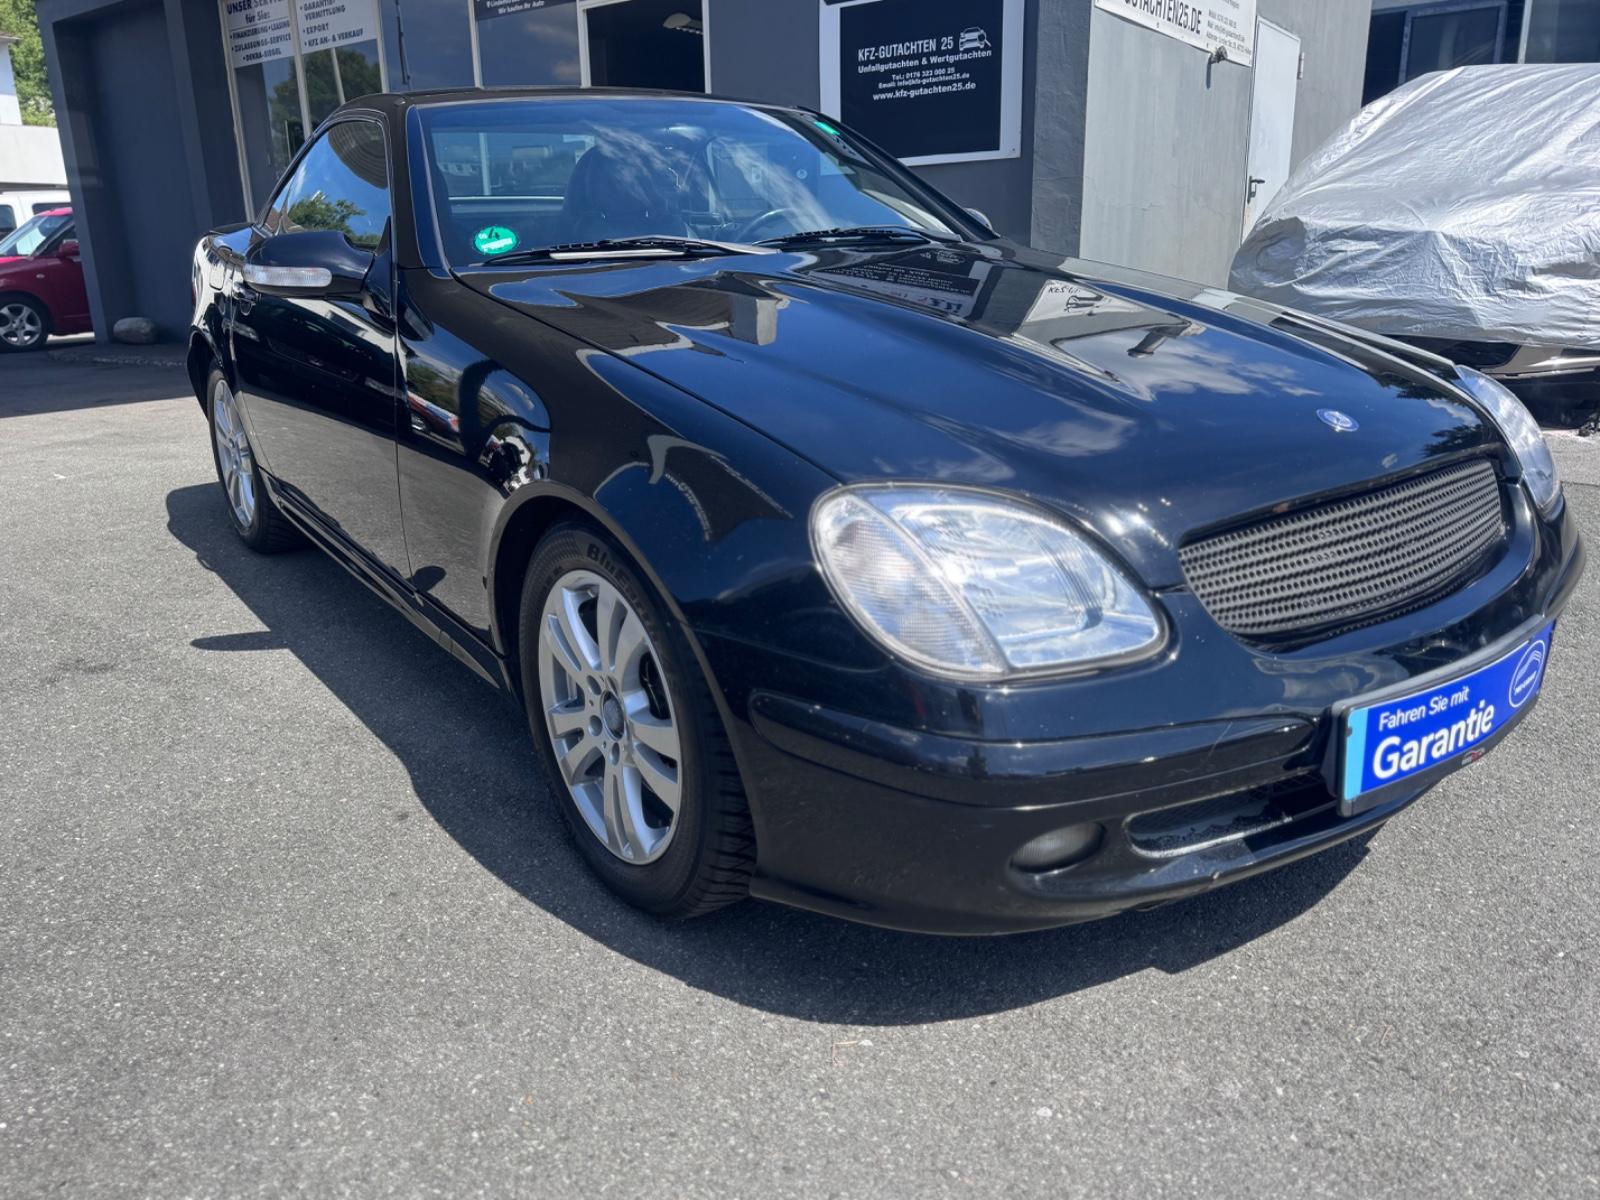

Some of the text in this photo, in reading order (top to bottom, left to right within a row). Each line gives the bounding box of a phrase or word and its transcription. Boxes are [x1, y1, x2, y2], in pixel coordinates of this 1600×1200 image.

[227, 0, 252, 15] UNSER
[305, 4, 346, 20] VERMITTLUNG
[1124, 0, 1202, 35] ACHTEN25.DE
[245, 13, 256, 24] für
[307, 22, 329, 35] EXPORT
[337, 28, 364, 41] VERKAUF
[858, 36, 954, 62] KFZ-GUTACHTEN 25
[858, 50, 992, 73] Unfallgutachten & Wertgutachten
[873, 81, 977, 101] www.kfz-gutachten25.de
[1379, 686, 1470, 732] Fahren Sie mit
[1372, 699, 1496, 780] Garantie
